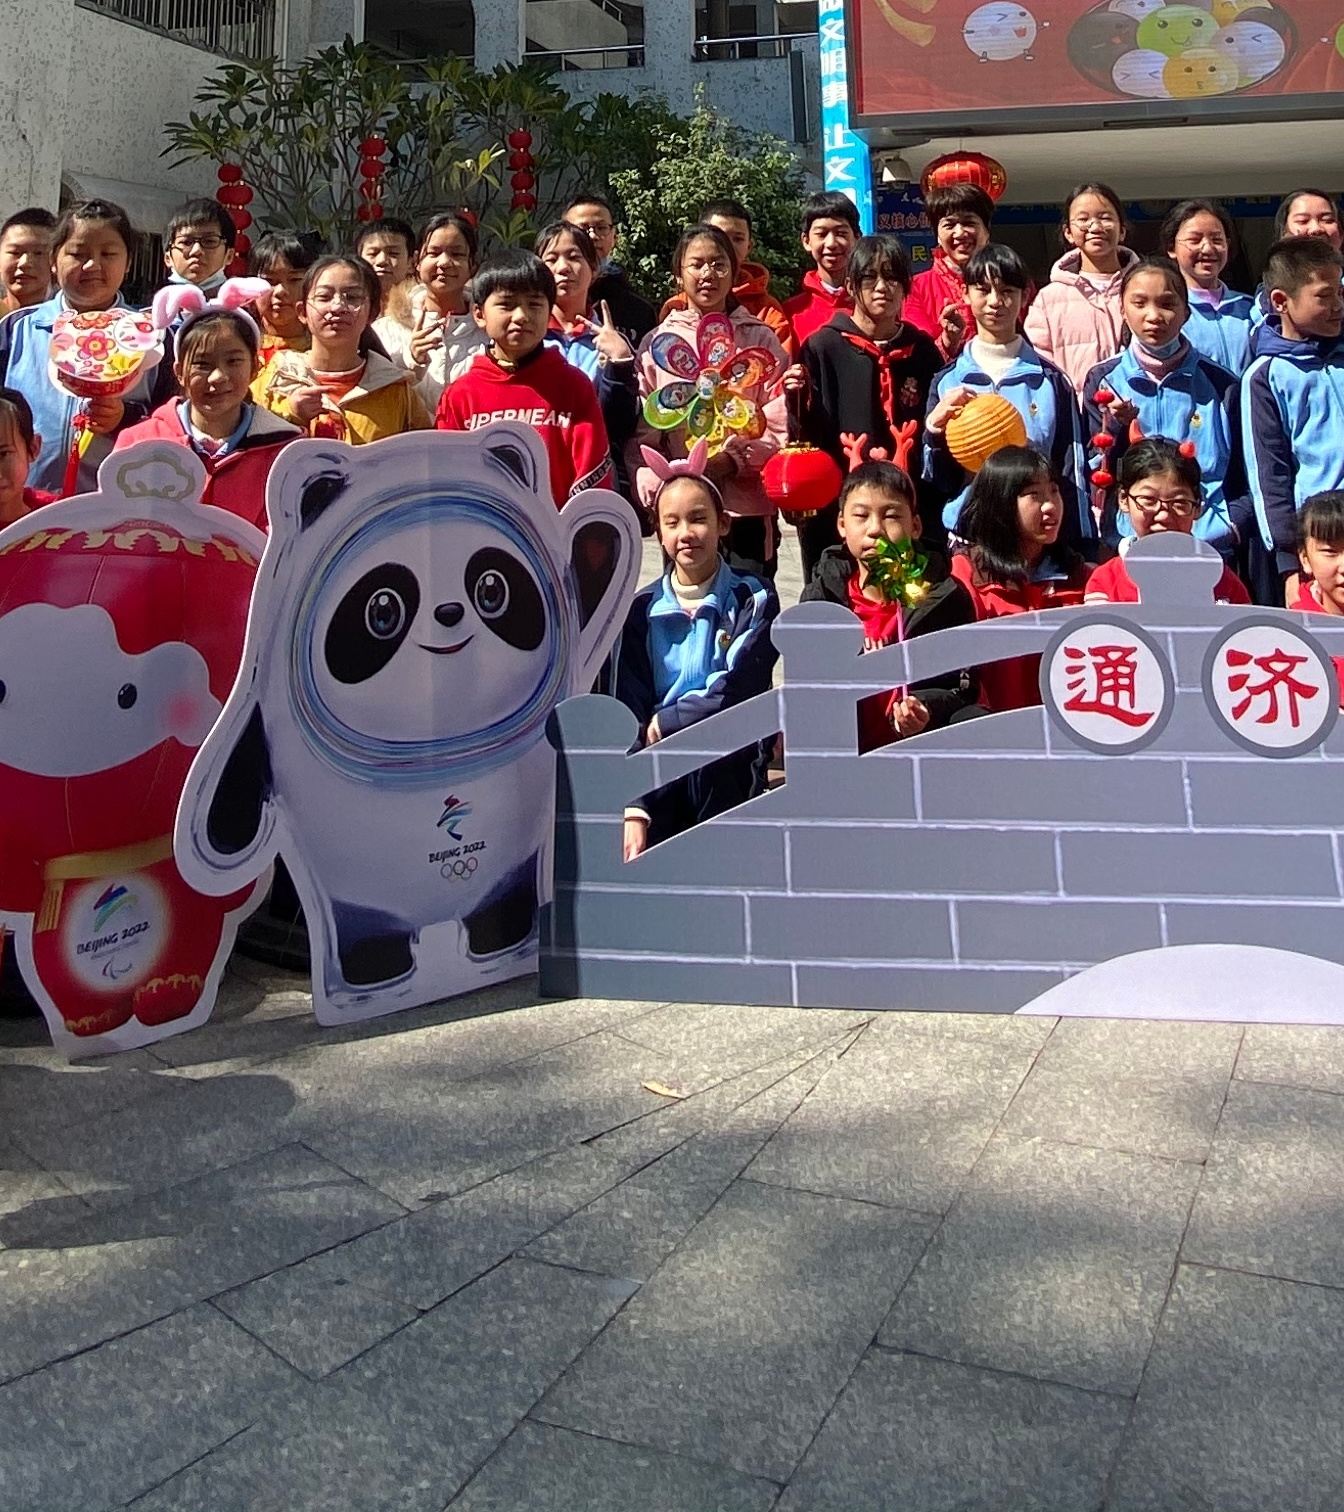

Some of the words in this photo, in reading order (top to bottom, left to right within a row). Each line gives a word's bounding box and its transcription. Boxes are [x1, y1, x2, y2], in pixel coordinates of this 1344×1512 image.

[1063, 644, 1319, 728] 通济
[429, 847, 461, 863] BEIJING
[463, 841, 487, 855] 2022
[76, 933, 118, 955] BEIJING
[121, 921, 150, 940] 2022
